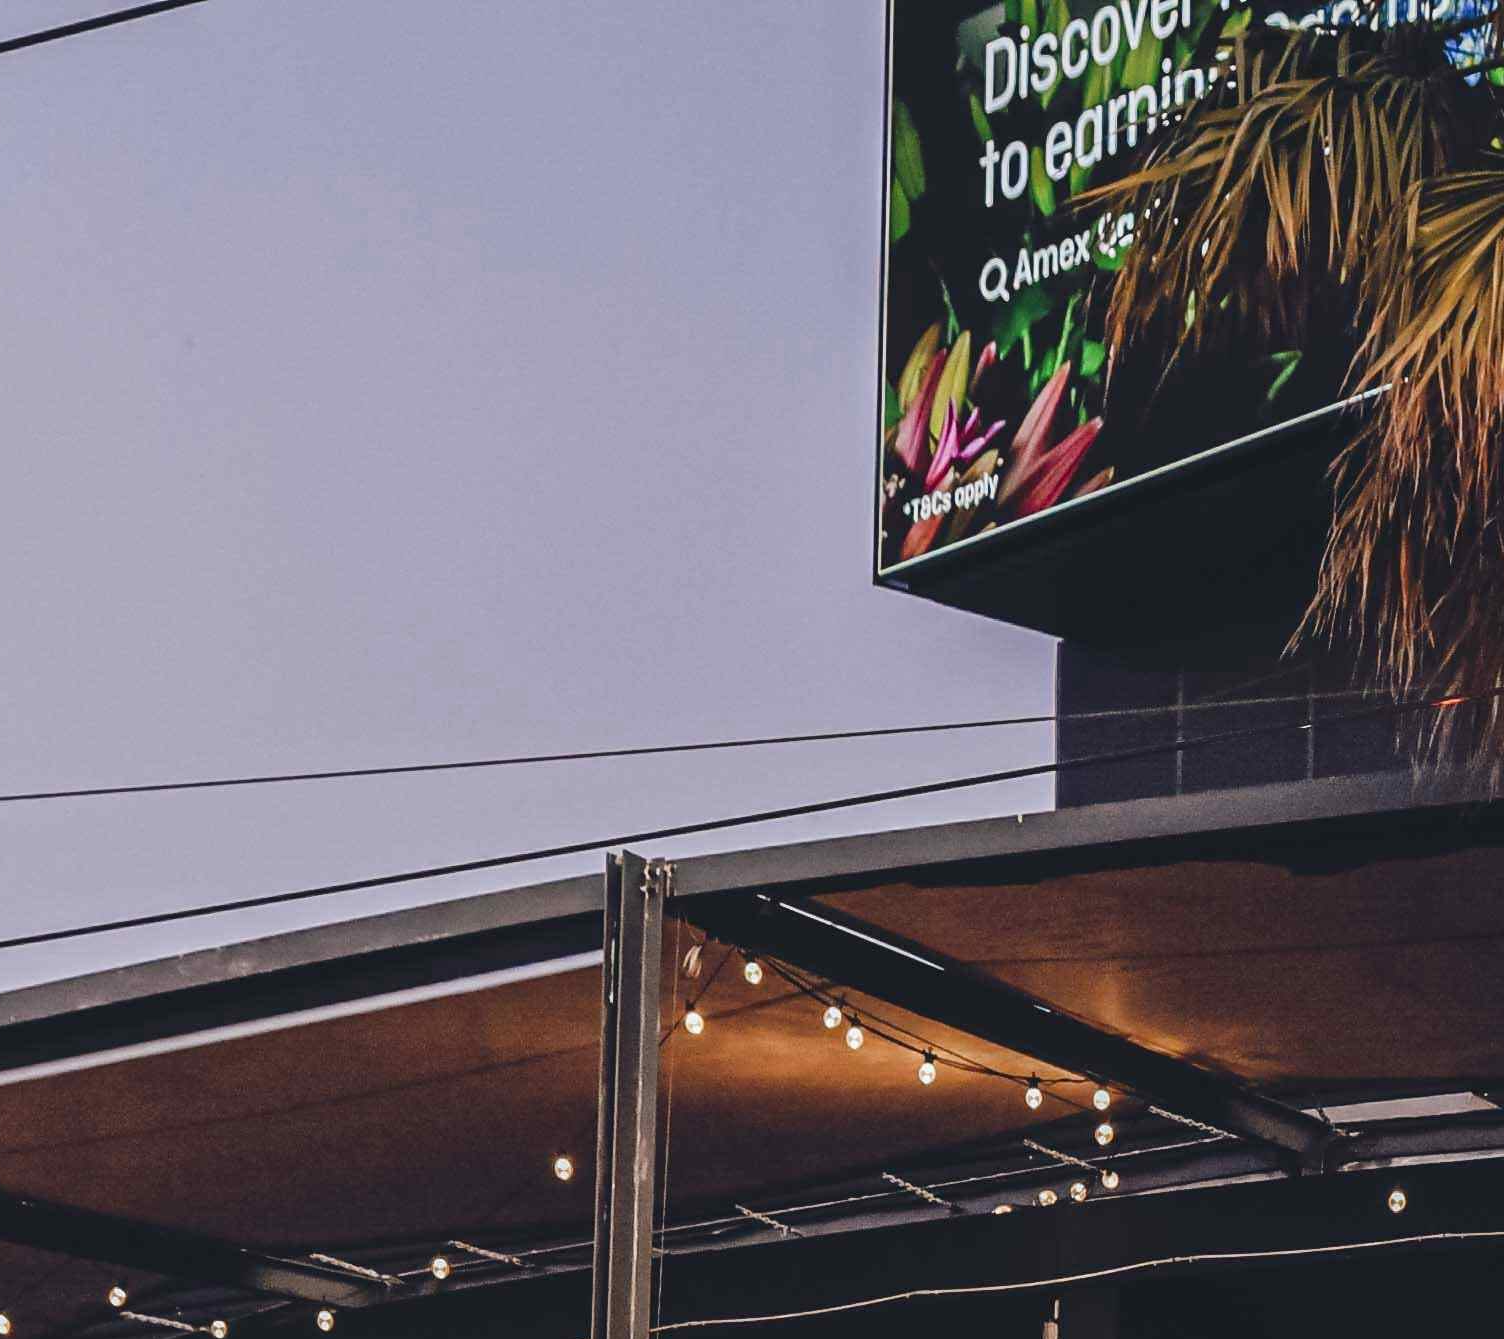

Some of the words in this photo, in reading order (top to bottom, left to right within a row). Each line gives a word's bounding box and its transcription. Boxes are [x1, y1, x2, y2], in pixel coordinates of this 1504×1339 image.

[979, 139, 1029, 208] to
[1013, 230, 1090, 290] Amex
[955, 472, 999, 510] apply
